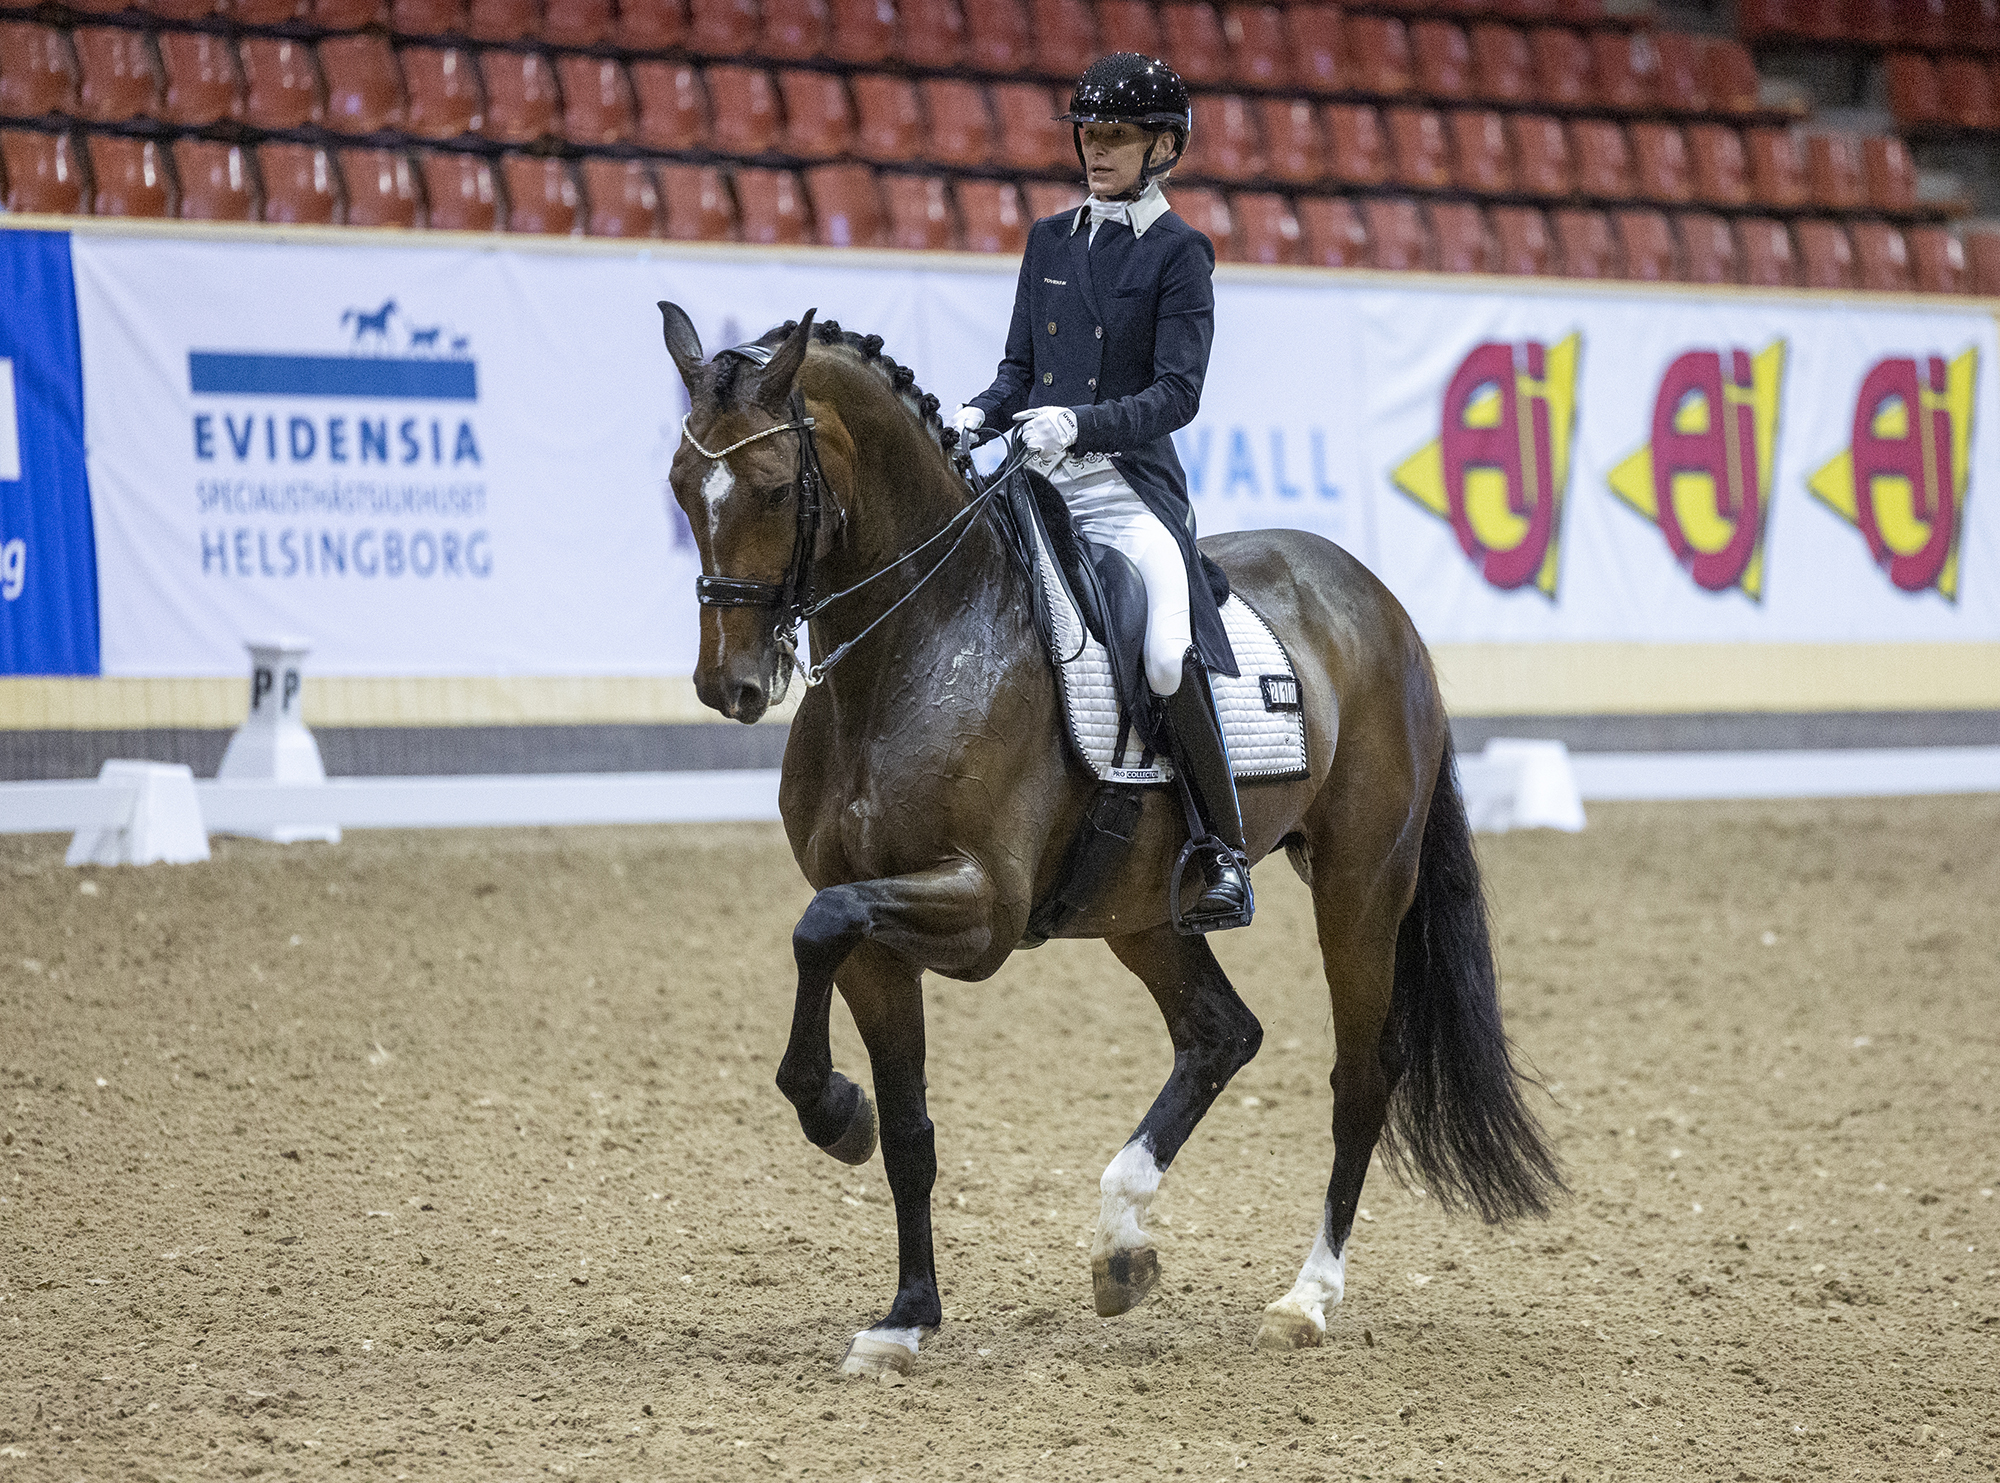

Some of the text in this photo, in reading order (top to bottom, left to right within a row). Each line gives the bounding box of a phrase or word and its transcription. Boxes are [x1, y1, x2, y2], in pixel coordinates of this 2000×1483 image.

[193, 413, 484, 466] EVIDENSIA
[200, 527, 493, 578] HELSINGBORG
[252, 666, 273, 712] P
[282, 667, 300, 714] P
[1270, 682, 1296, 702] 210
